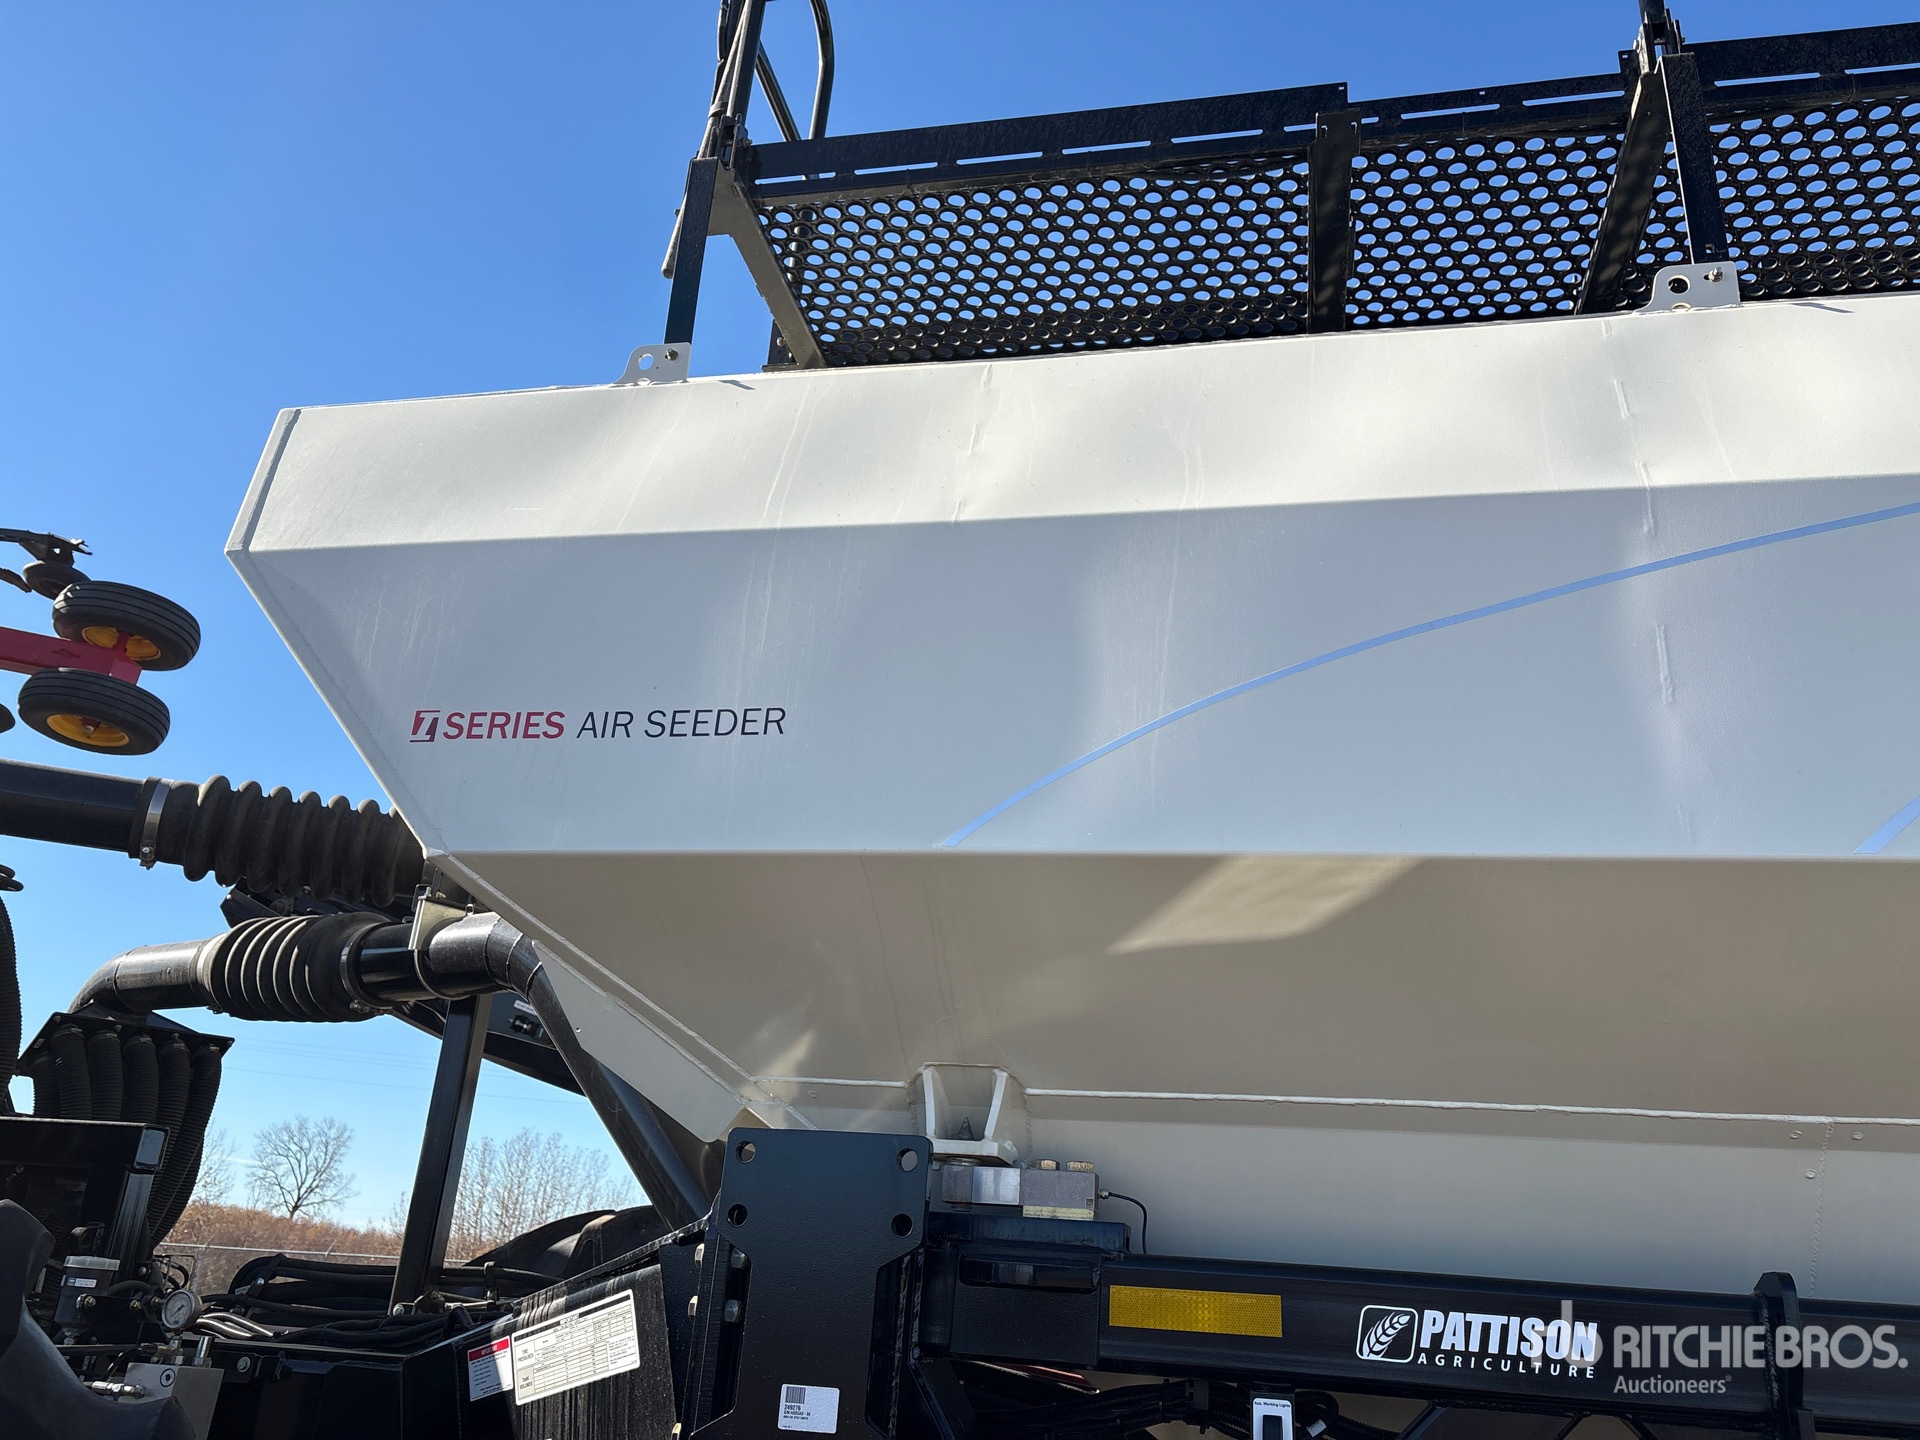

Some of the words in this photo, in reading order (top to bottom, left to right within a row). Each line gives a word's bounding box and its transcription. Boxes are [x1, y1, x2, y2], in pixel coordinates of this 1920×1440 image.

[576, 711, 634, 739] AIR
[644, 707, 787, 738] SEEDER
[1420, 1309, 1598, 1362] PATTISON
[1417, 1352, 1595, 1379] AGRICULTURE
